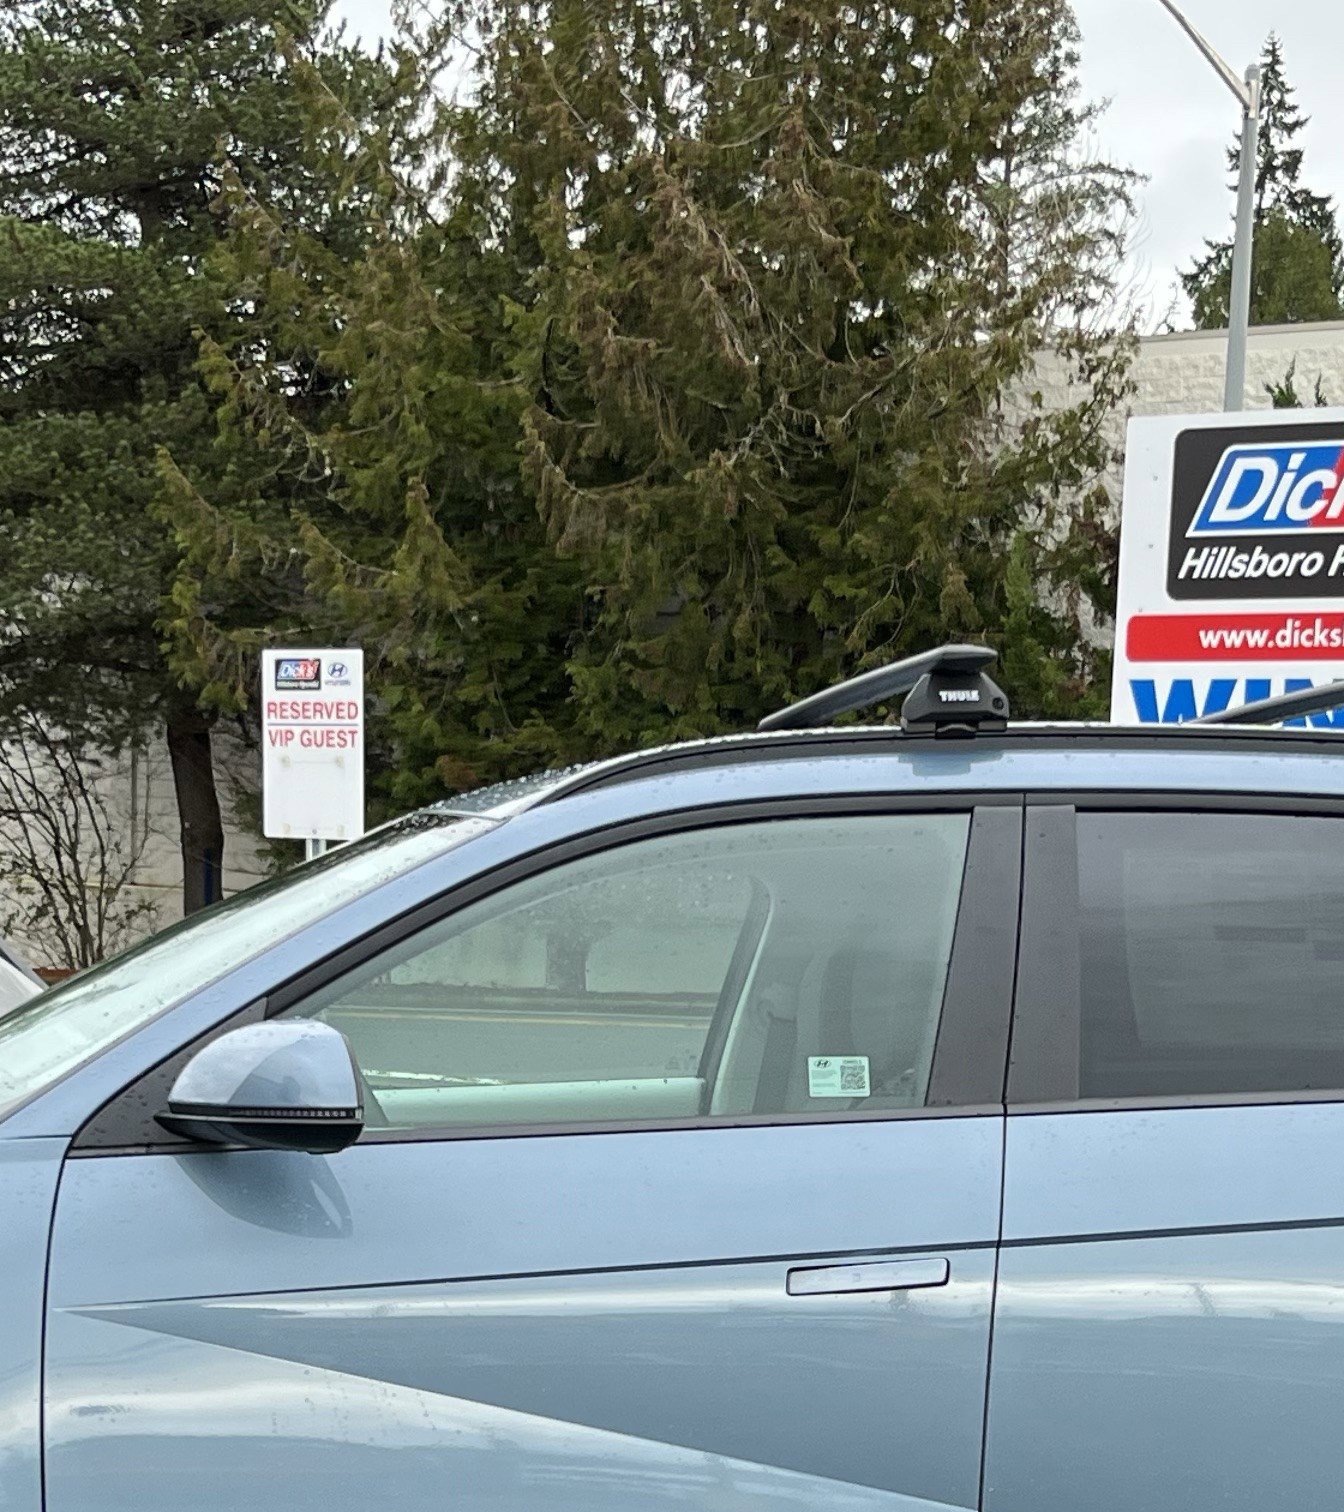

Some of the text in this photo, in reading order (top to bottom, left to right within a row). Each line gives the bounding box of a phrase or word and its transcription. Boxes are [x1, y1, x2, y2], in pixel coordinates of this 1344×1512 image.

[1177, 545, 1325, 580] Hillsboro
[938, 689, 980, 702] THULE
[267, 701, 358, 720] RESERVED
[268, 729, 358, 749] VIP GUEST
